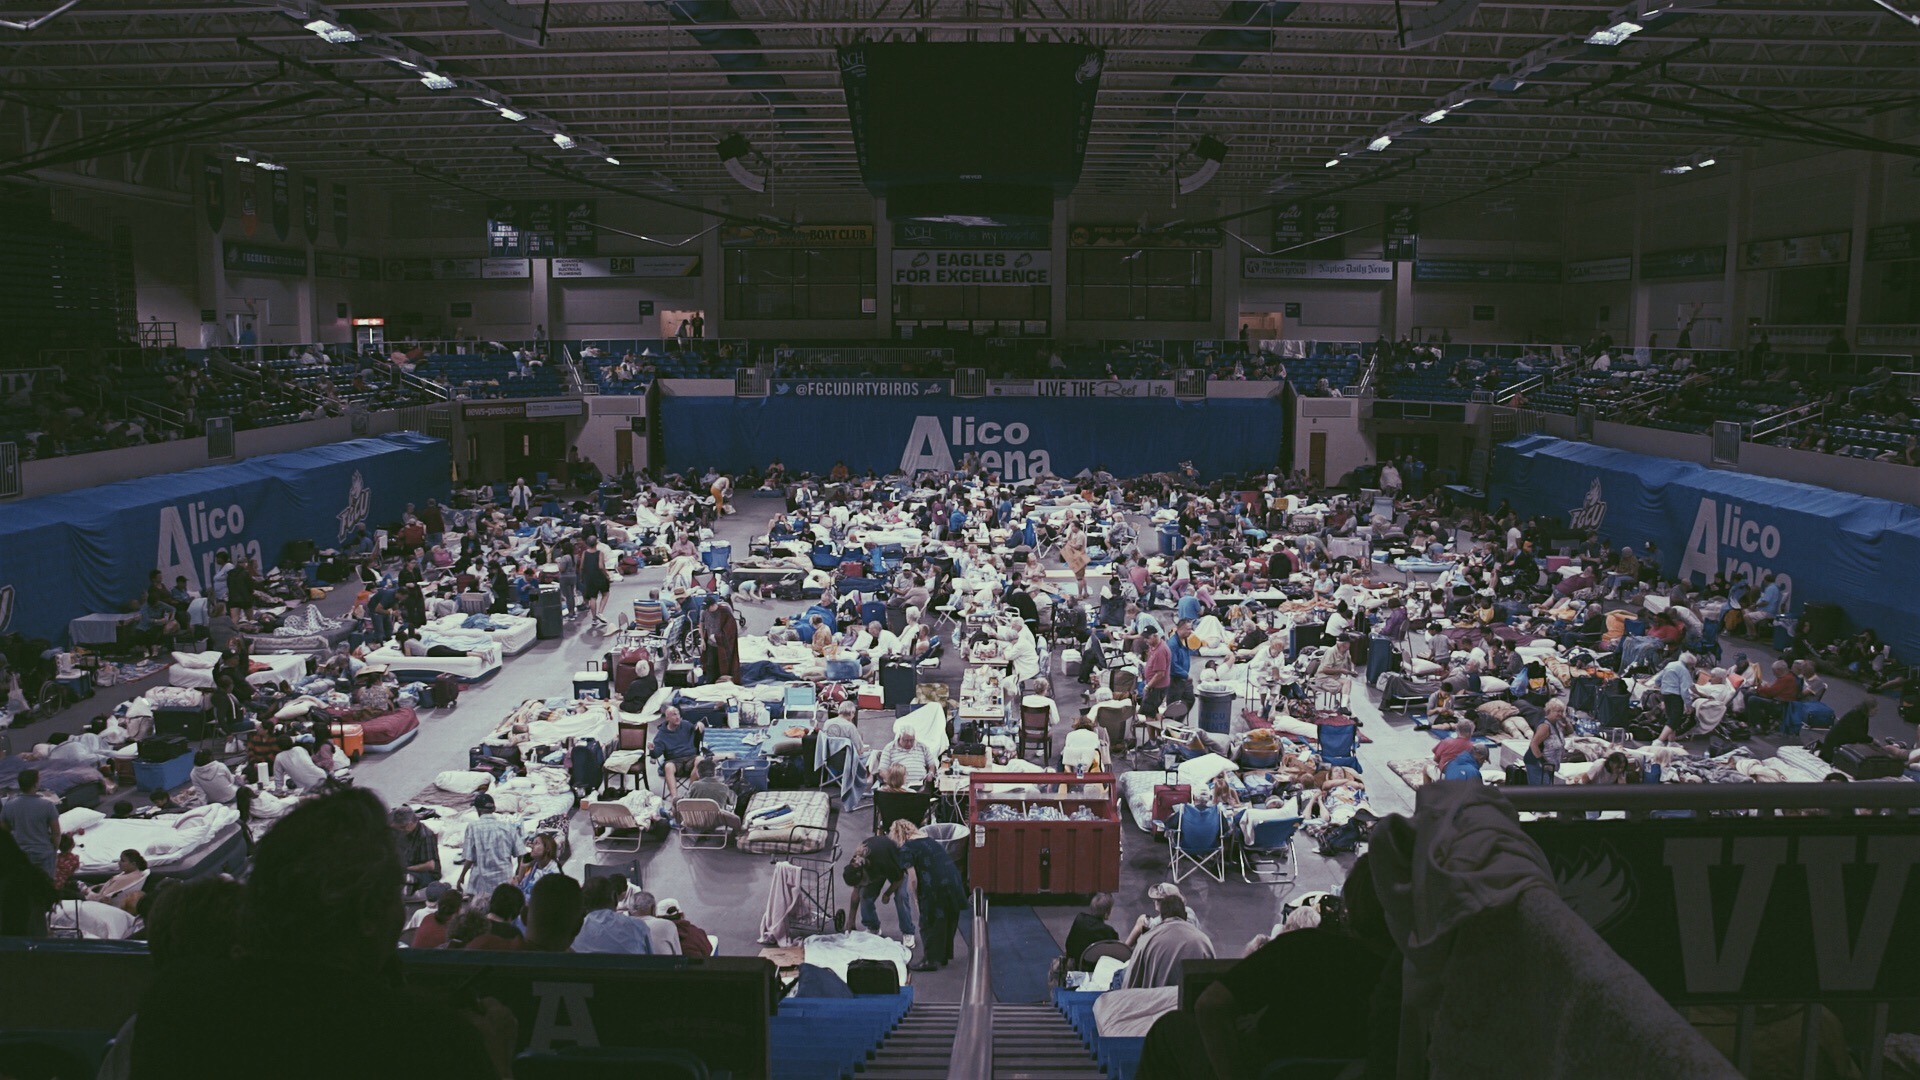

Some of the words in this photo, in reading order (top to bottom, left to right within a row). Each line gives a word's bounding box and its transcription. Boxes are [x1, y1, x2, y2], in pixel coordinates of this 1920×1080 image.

[809, 229, 838, 241] BOAT
[838, 229, 867, 241] CLUB
[904, 227, 932, 238] NCH
[982, 232, 997, 246] my
[937, 254, 1006, 267] EAGLES
[1318, 263, 1345, 276] Naples
[1346, 263, 1367, 276] Daily
[1368, 264, 1390, 276] News
[896, 270, 930, 283] FOR
[936, 270, 1048, 283] EXCELLENCE
[795, 383, 919, 396] @FGCUDIRTYBIRDS
[1038, 382, 1066, 396] LIVE
[1071, 382, 1097, 396] THE
